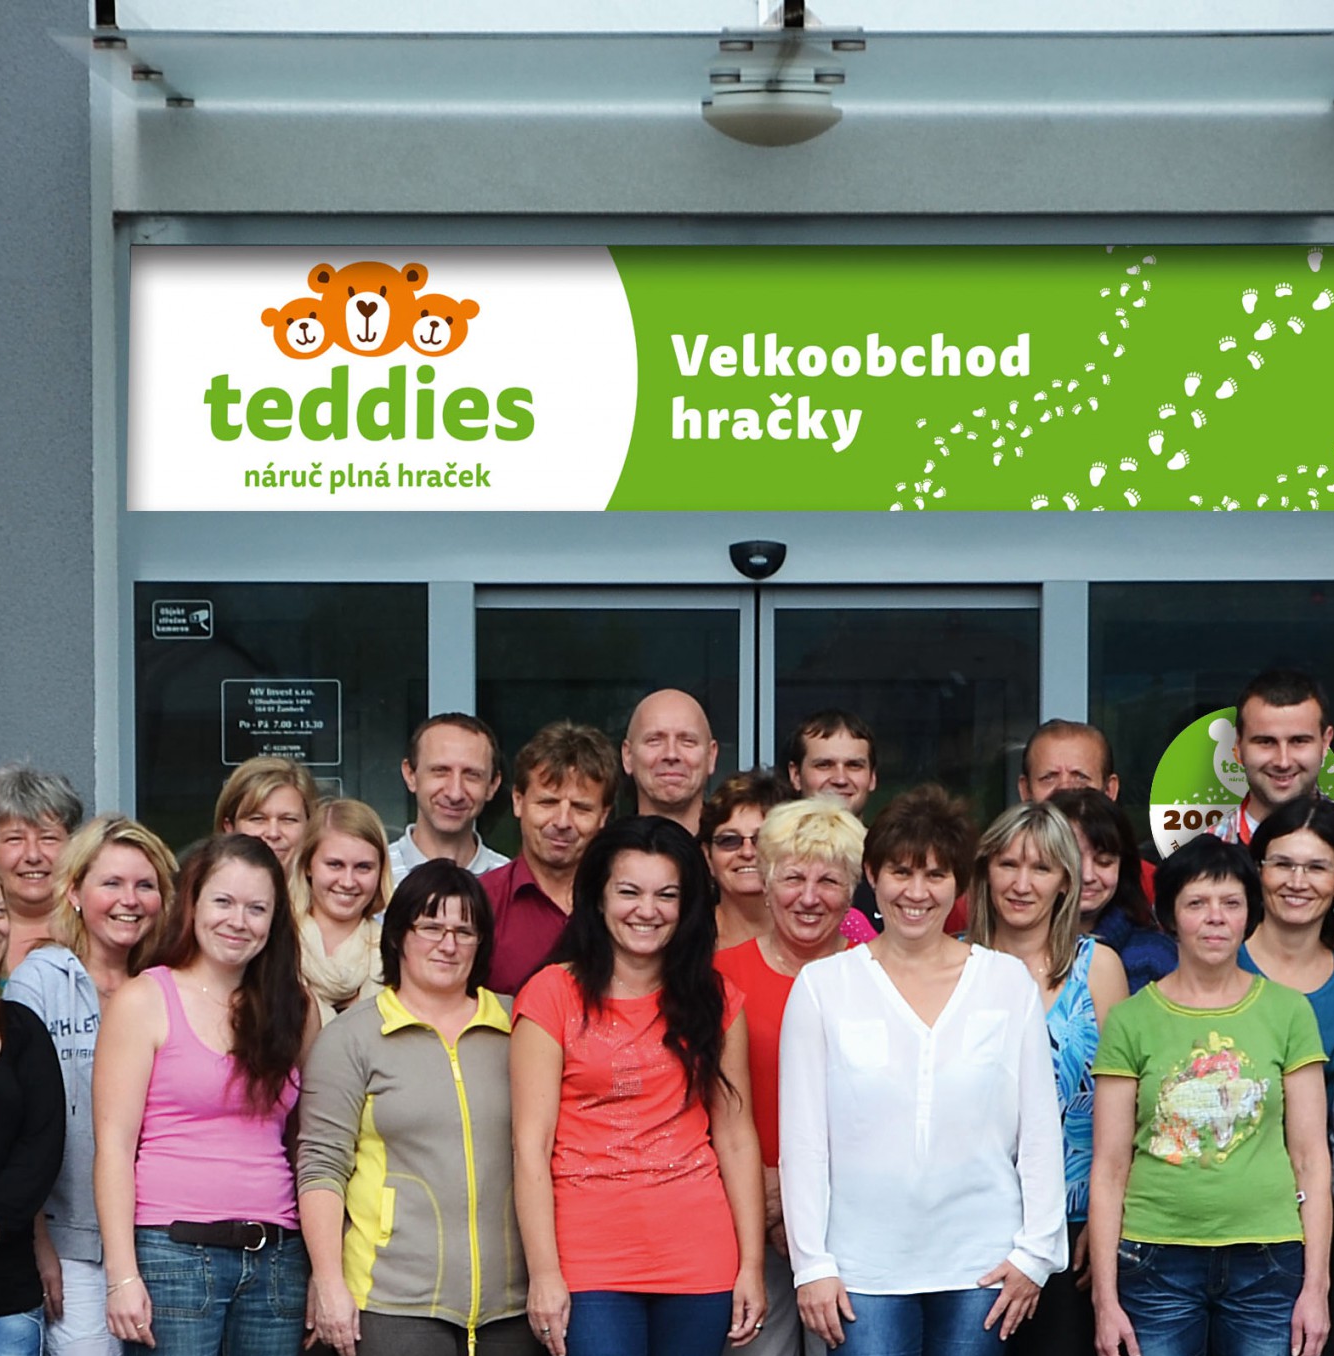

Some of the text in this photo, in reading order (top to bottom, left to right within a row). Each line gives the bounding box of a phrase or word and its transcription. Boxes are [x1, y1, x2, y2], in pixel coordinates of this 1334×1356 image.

[670, 332, 1030, 377] Velkoobchod
[203, 363, 536, 442] teddies
[672, 392, 863, 453] hračky
[244, 462, 491, 495] náruč plná hraček
[267, 687, 293, 696] Invest
[239, 720, 251, 729] Po
[273, 720, 293, 729] 7.00
[300, 720, 324, 729] 15.30
